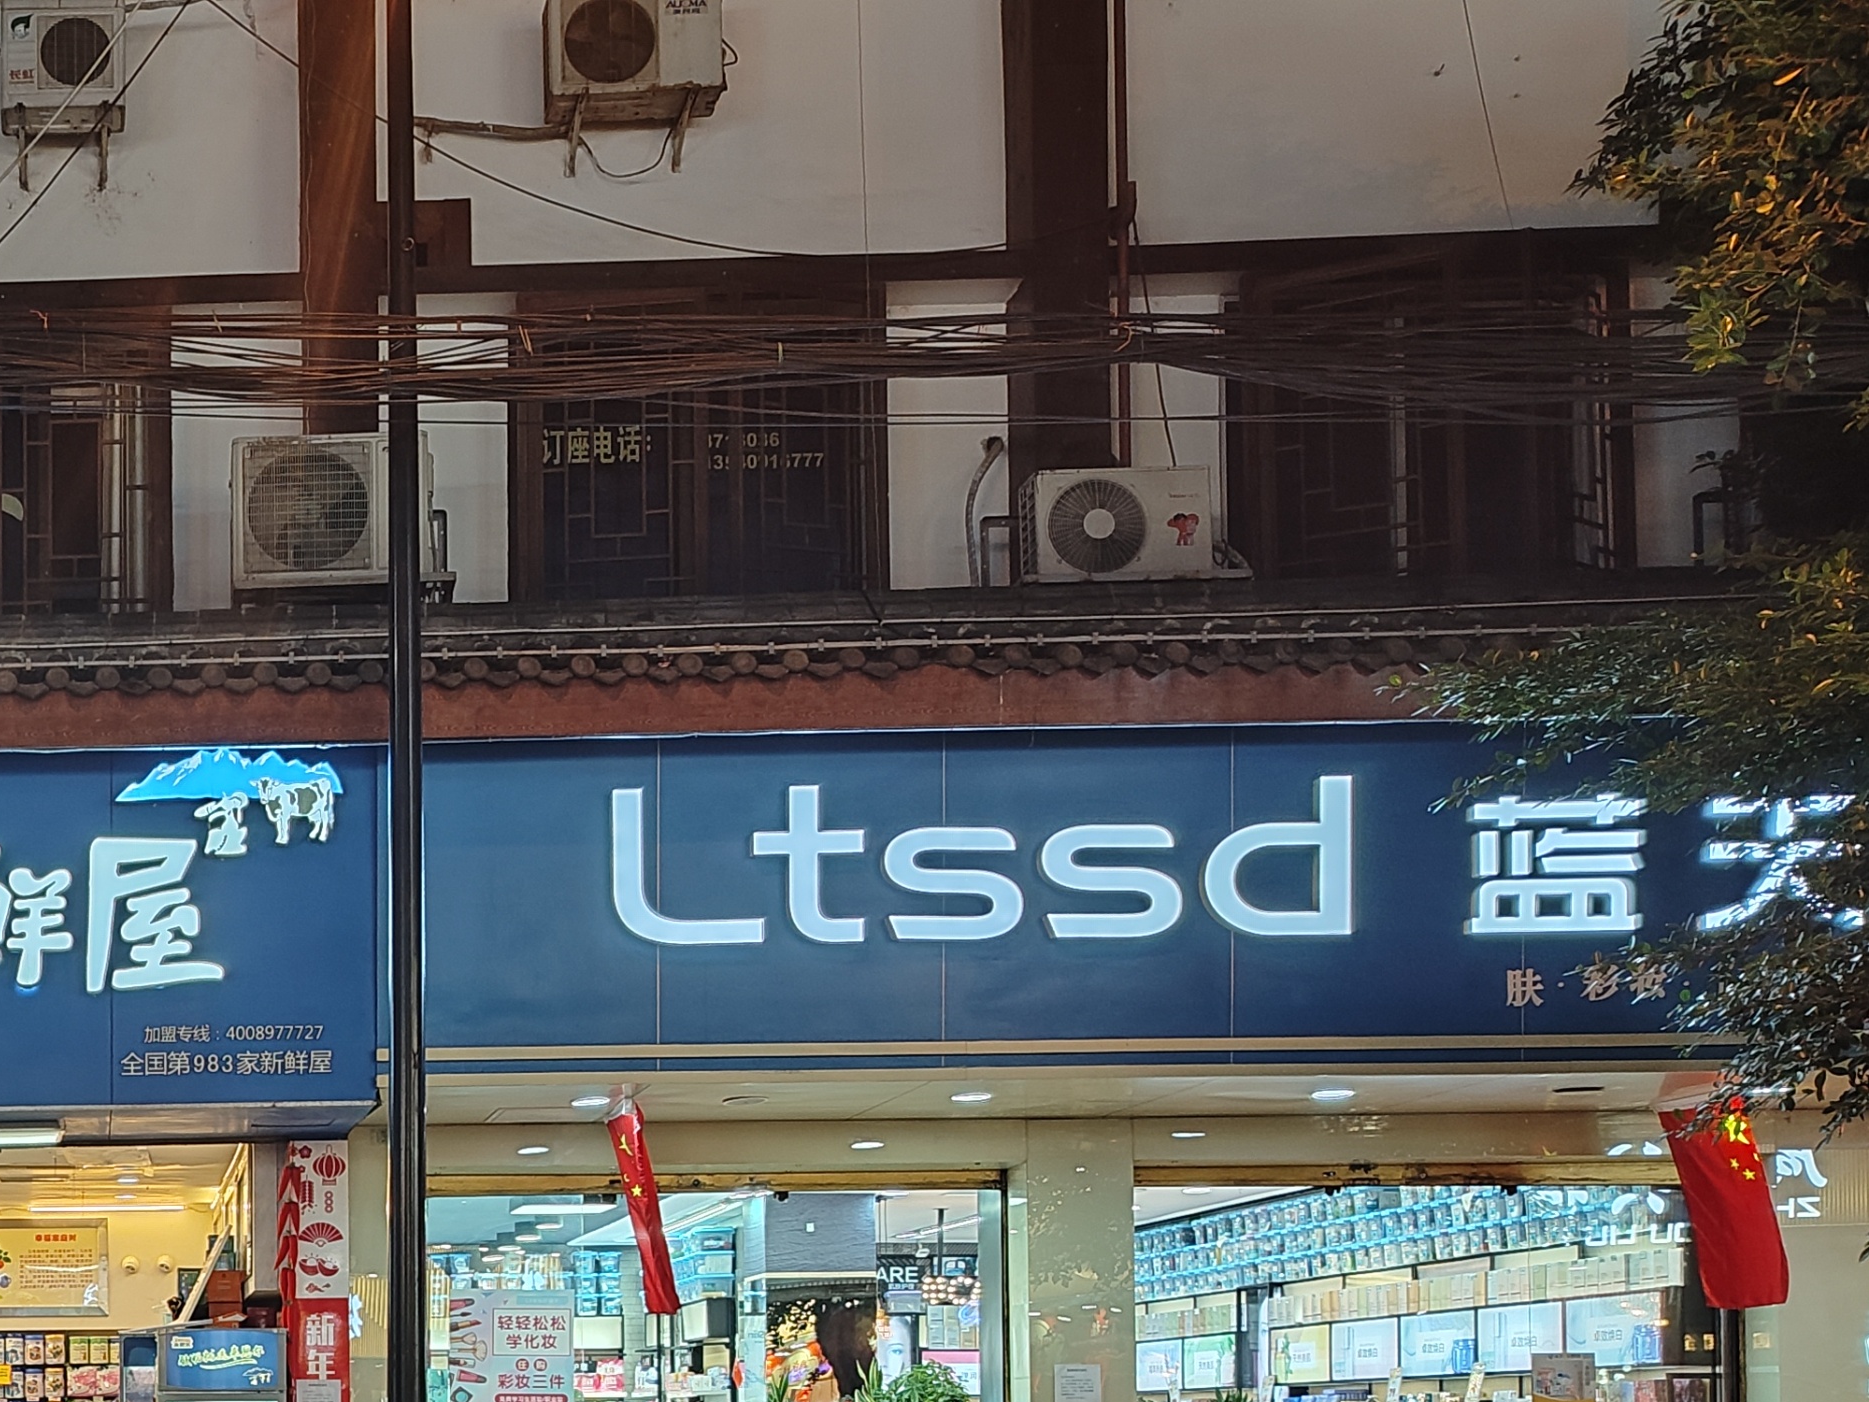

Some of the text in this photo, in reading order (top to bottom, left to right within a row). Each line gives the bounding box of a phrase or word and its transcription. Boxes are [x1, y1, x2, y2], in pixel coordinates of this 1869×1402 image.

[612, 774, 1358, 944] Ltssd
[120, 1050, 333, 1076] 全国第983家新鲜屋
[497, 1315, 566, 1331] 轻轻松松
[506, 1334, 557, 1349] 学化妆
[497, 1373, 566, 1389] 彩妆三件
